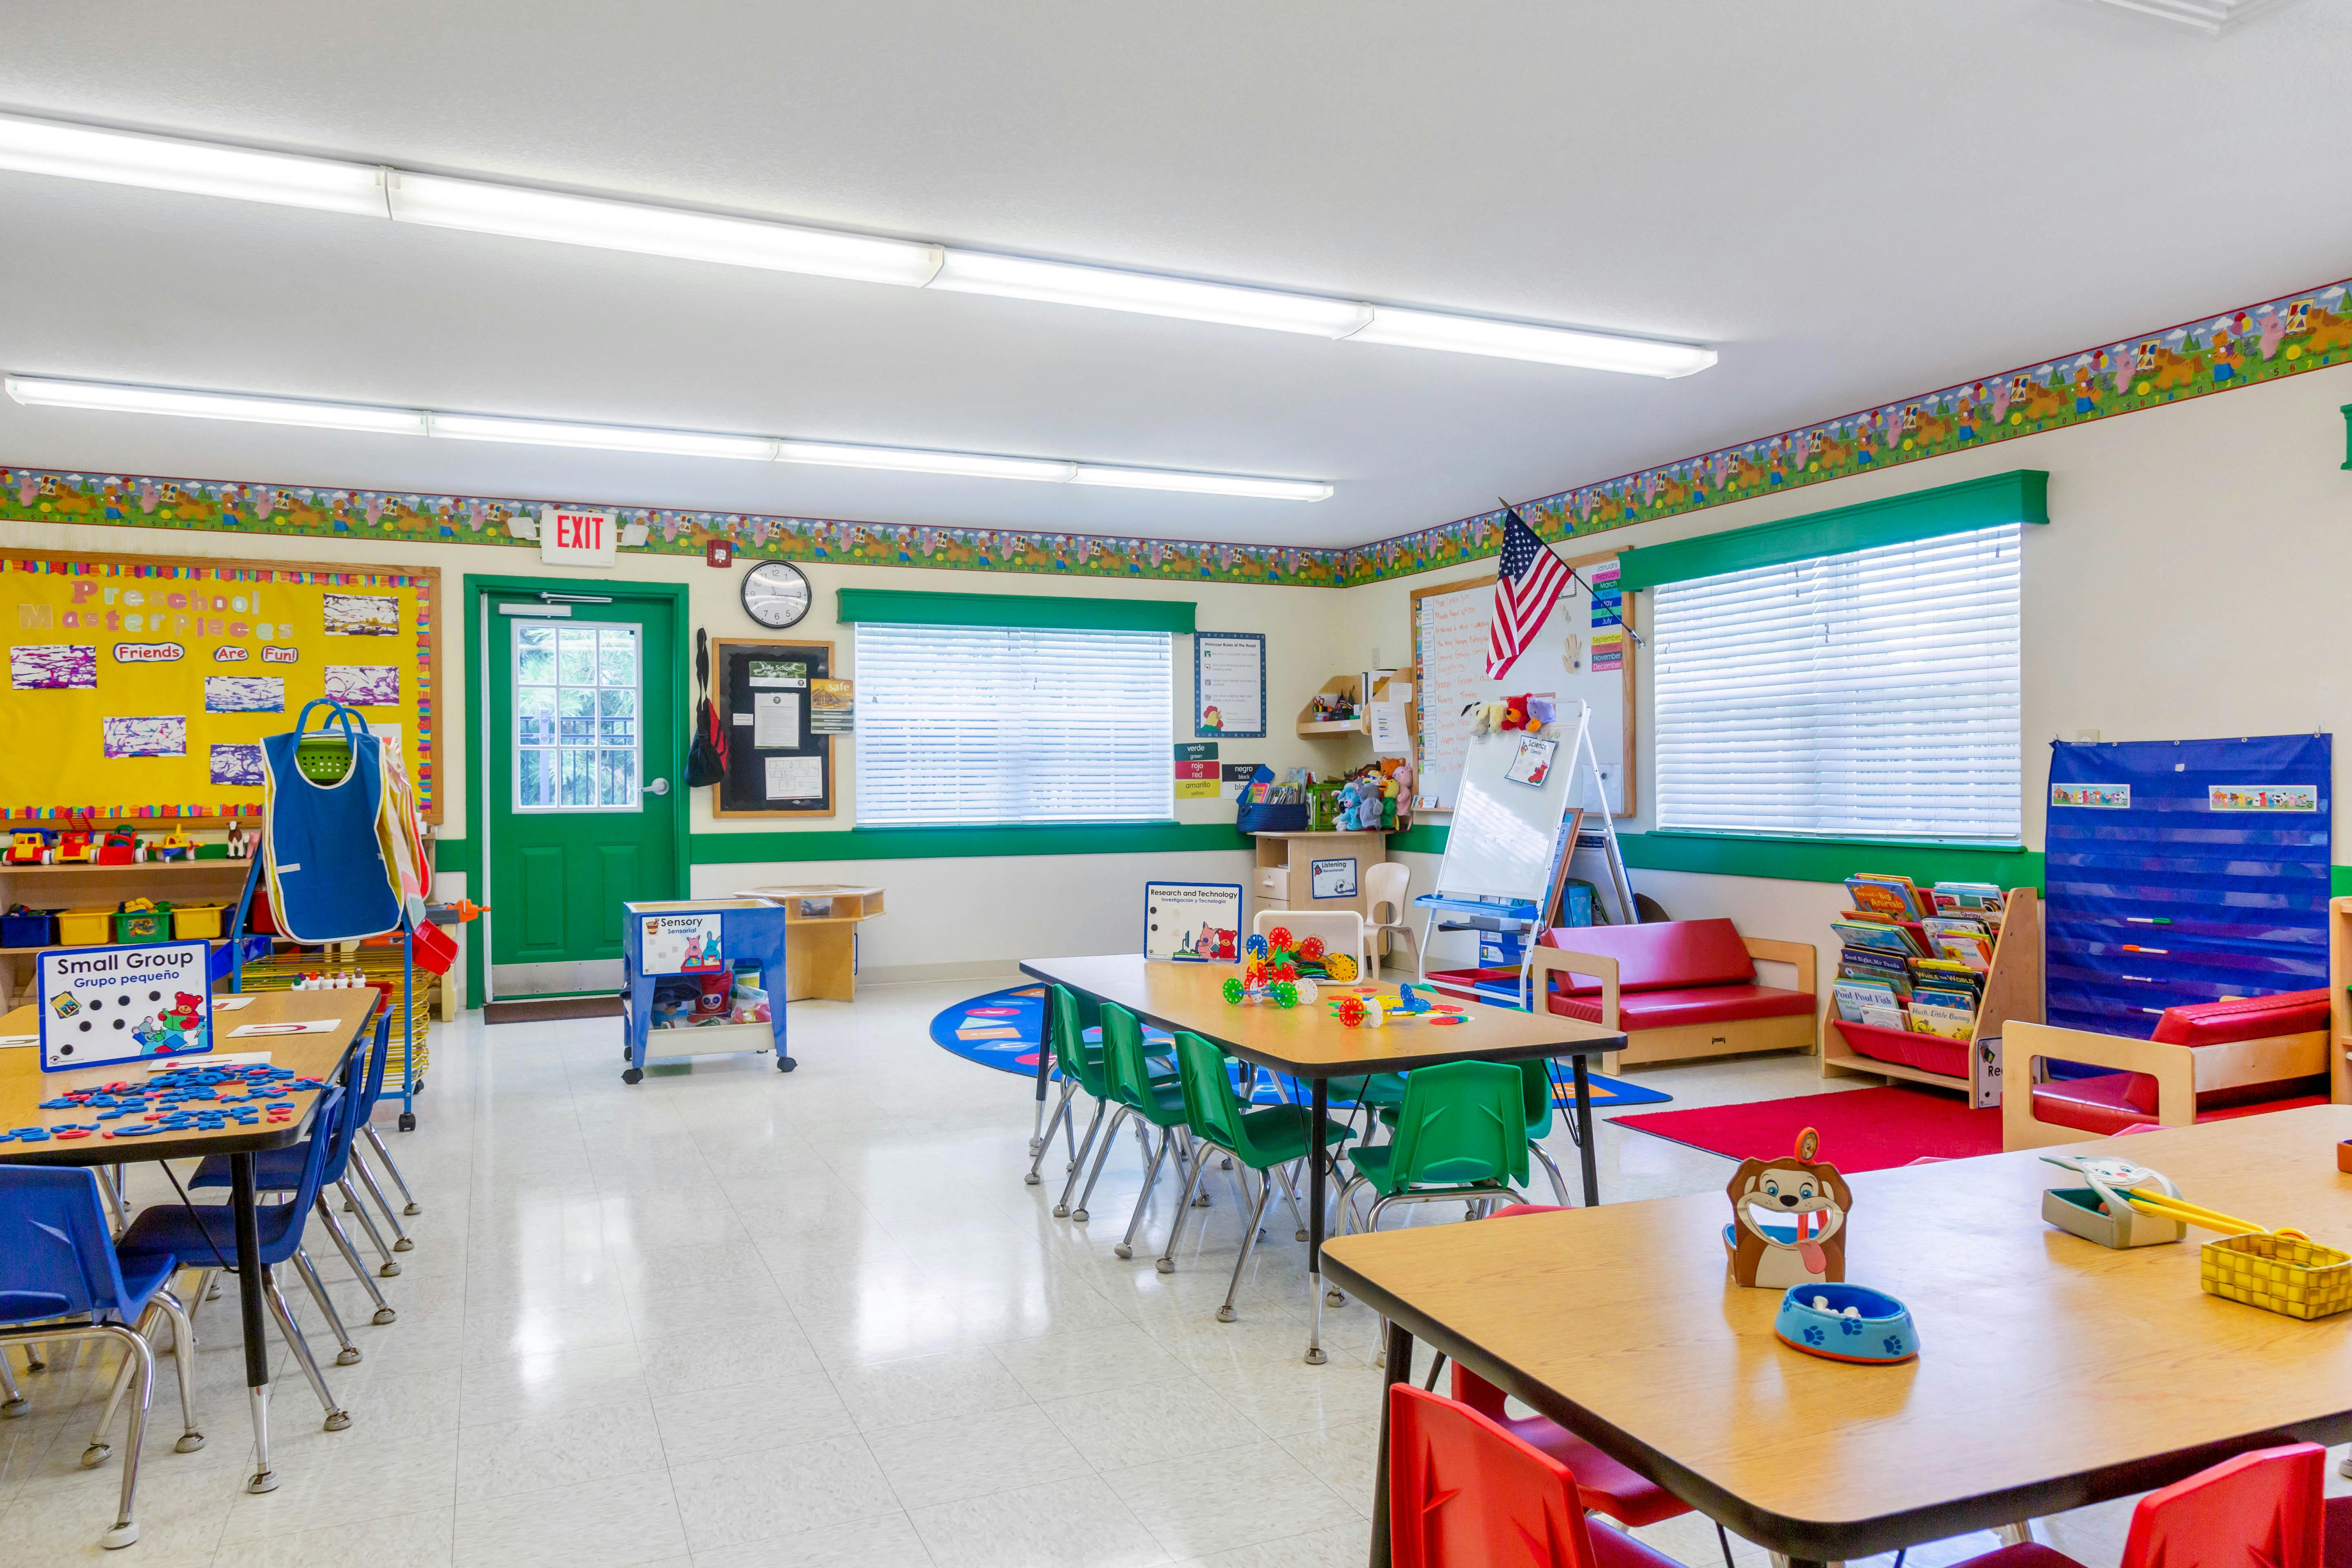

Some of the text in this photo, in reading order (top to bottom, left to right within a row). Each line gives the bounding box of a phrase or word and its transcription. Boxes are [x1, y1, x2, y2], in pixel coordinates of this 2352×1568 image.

[557, 515, 604, 549] EXIT
[1597, 562, 1618, 572] January
[1596, 572, 1619, 581] February
[1600, 580, 1617, 589] March
[71, 580, 260, 615] Preschool
[18, 604, 293, 640] Masterpieces
[1592, 634, 1621, 644] September
[119, 646, 180, 659] Friends
[217, 648, 246, 659] Are
[265, 649, 295, 660] Fun!
[1594, 653, 1621, 662] November
[1593, 662, 1621, 670] December
[829, 682, 850, 691] safe
[1528, 740, 1547, 750] Science
[1192, 763, 1203, 771] rojo
[1198, 891, 1238, 899] Technology
[1879, 893, 1891, 901] Big
[1871, 899, 1904, 909] Animals
[661, 918, 702, 927] Sensory
[57, 952, 194, 975] Small Group
[74, 970, 180, 988] Grupo pequeño
[1915, 971, 1940, 980] WHILE
[1947, 975, 1974, 984] WORLD
[1835, 990, 1891, 1004] Pout-Pout Fish
[1931, 1010, 1947, 1019] Little
[1949, 1013, 1970, 1023] Bunny
[1988, 1066, 2002, 1077] Re
